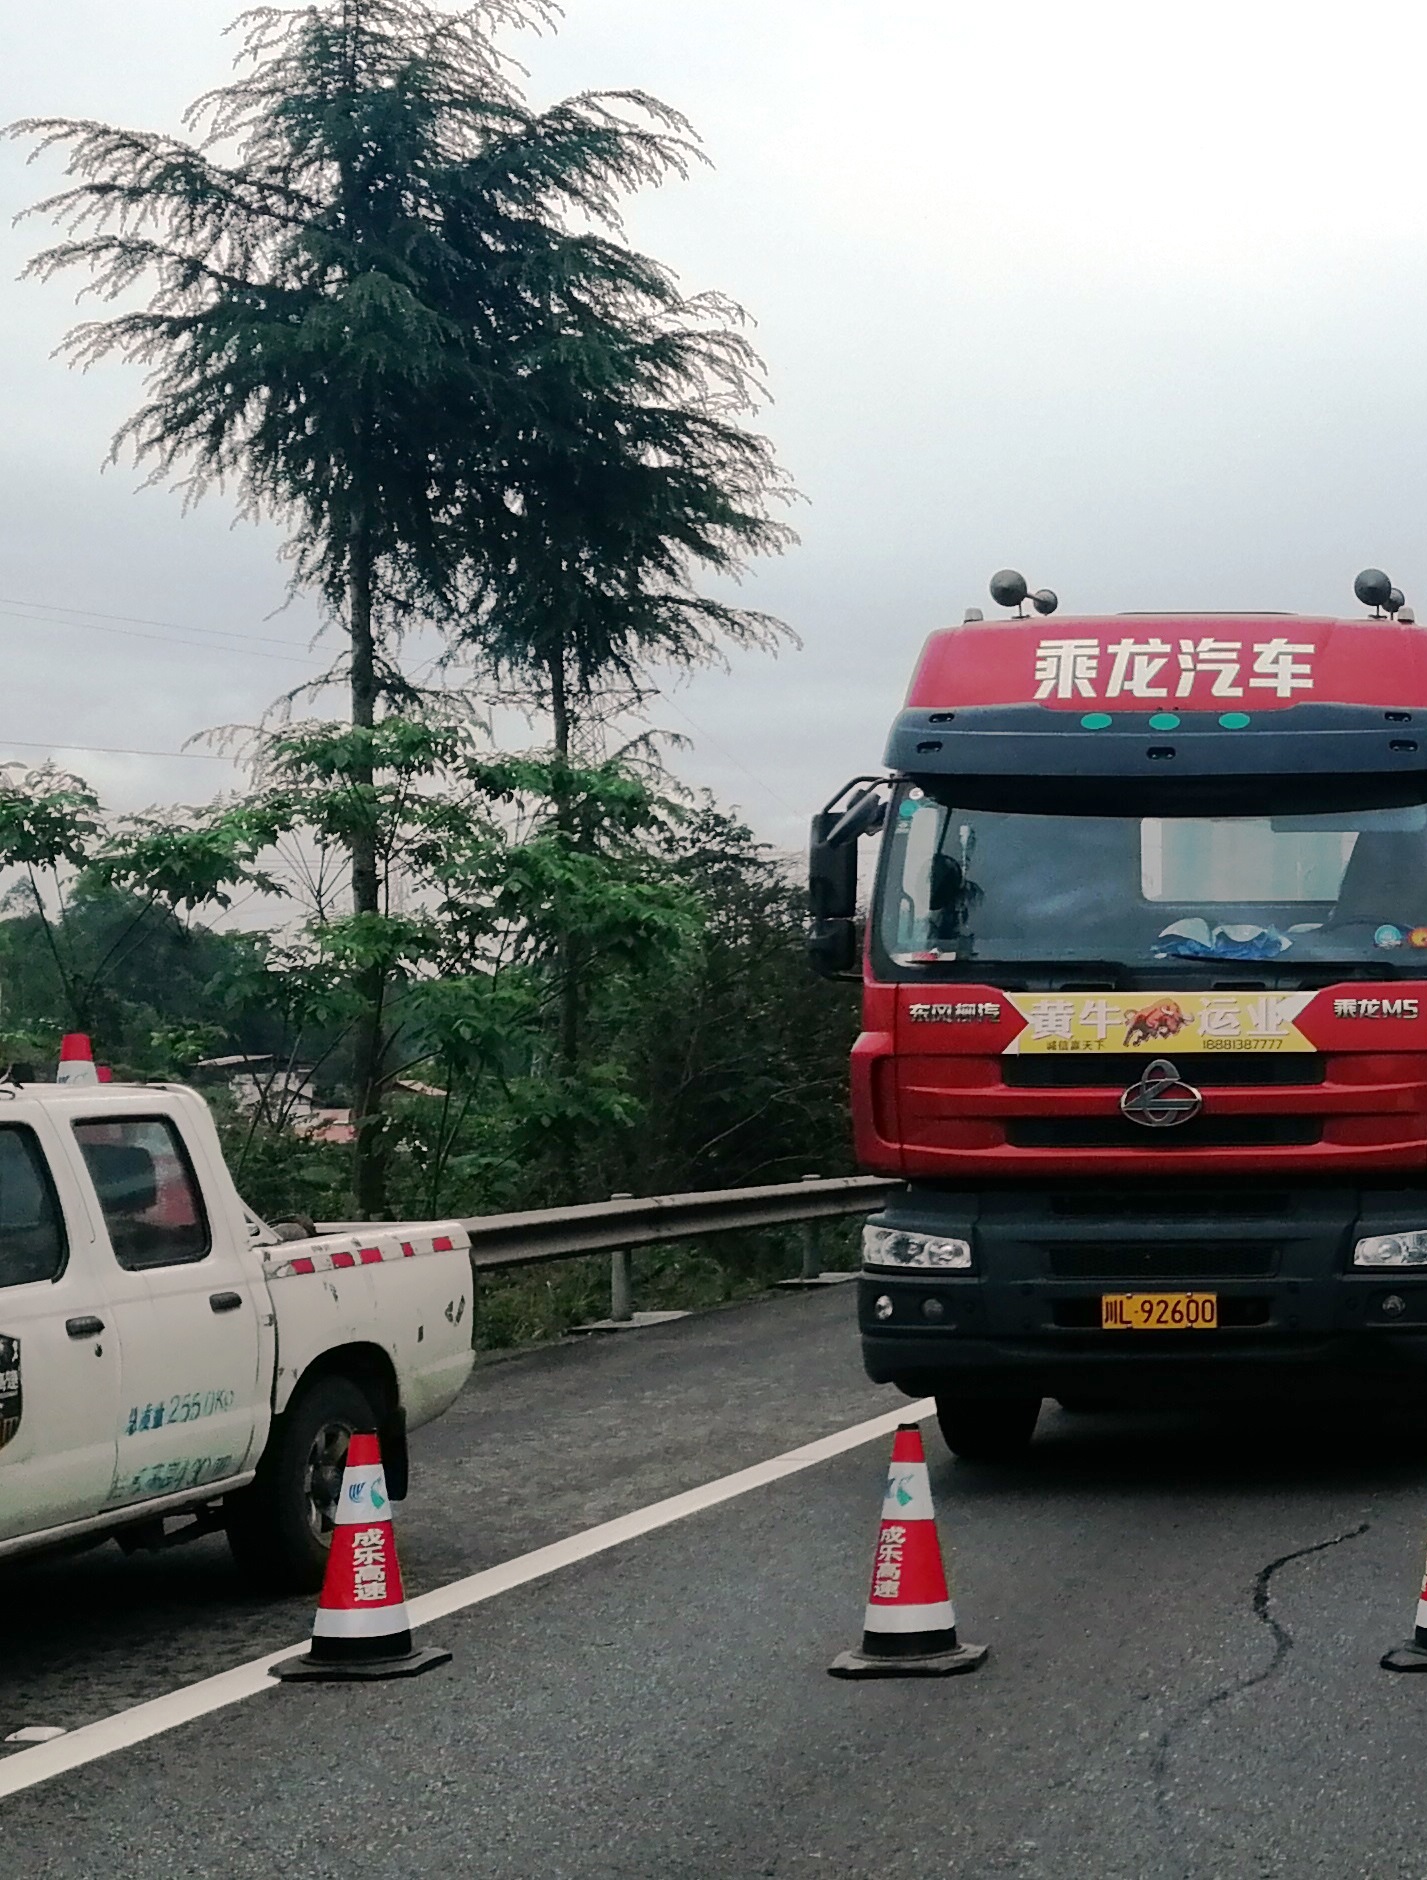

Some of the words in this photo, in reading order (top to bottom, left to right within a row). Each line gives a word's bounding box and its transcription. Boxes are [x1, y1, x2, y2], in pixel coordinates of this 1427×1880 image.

[1033, 638, 1315, 699] 乘龙汽车
[1030, 999, 1122, 1040] 黄牛
[1197, 996, 1290, 1037] 运业
[1333, 999, 1419, 1019] 乘龙M5
[1202, 1039, 1284, 1050] 18881387777
[351, 1528, 387, 1602] 成乐高速
[873, 1525, 907, 1599] 成乐高速
